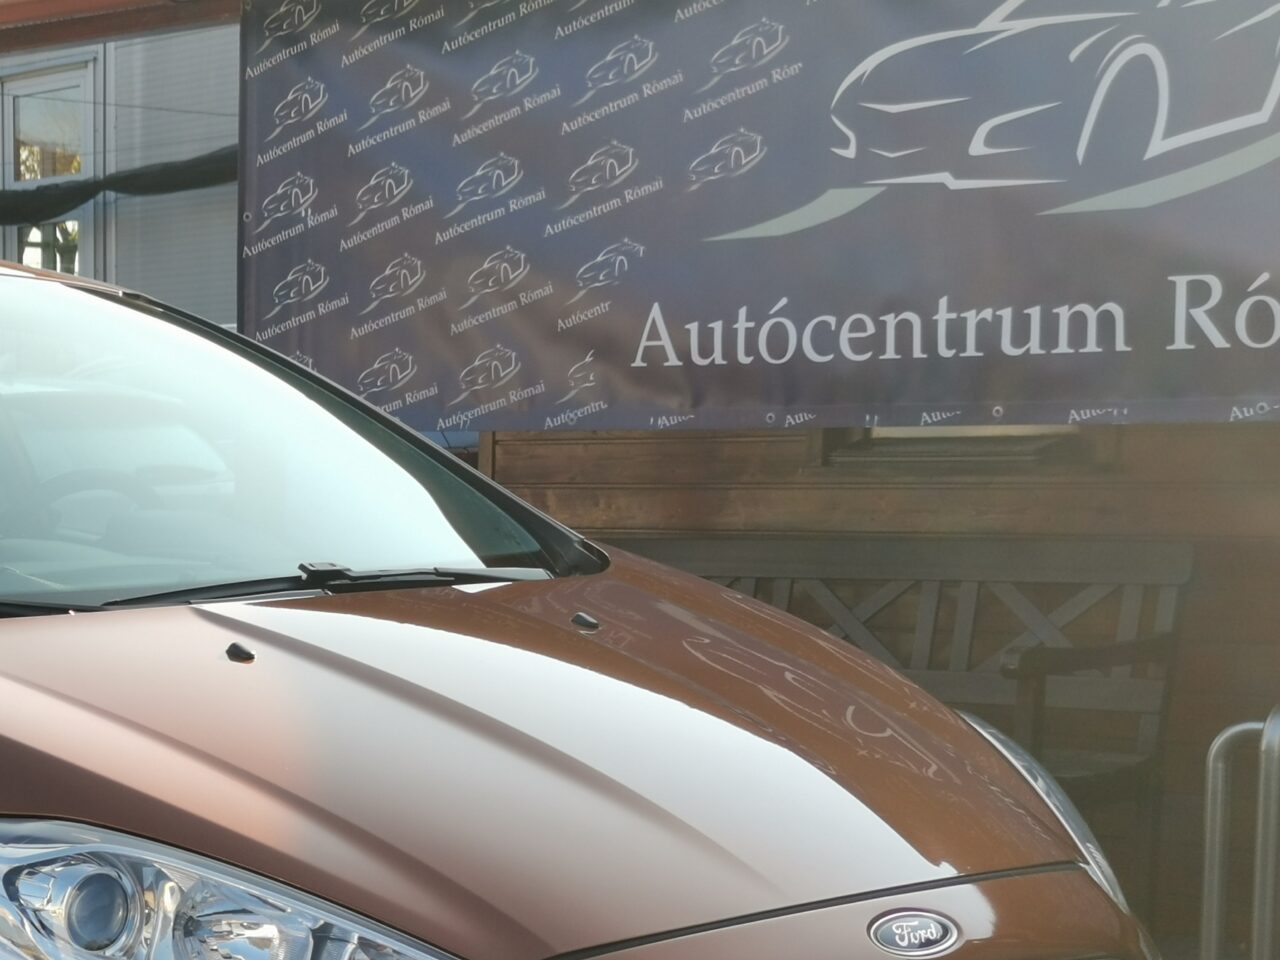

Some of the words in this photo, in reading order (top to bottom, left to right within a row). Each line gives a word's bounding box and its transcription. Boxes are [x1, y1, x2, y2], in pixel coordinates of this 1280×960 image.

[245, 40, 308, 80] Autócentrum
[309, 19, 340, 46] Római
[341, 25, 406, 68] Autócentrum
[409, 5, 445, 32] Római
[441, 11, 516, 54] Autócentrum
[347, 118, 416, 157] Autócentrum
[418, 97, 451, 124] Római
[452, 106, 522, 147] Autócentrum
[523, 83, 561, 112] Római
[560, 91, 639, 136] Autócentrum
[642, 69, 684, 98] Római
[683, 77, 768, 122] Autócentrum
[256, 128, 315, 167] Autócentrum
[316, 109, 348, 135] Római
[242, 221, 304, 258] Autócentrum
[307, 204, 338, 229] Római
[340, 215, 400, 252] Autócentrum
[401, 195, 434, 220] Római
[435, 206, 505, 245] Autócentrum
[508, 186, 546, 212] Római
[543, 195, 622, 238] Autócentrum
[624, 176, 664, 203] Római
[255, 309, 315, 343] Autócentrum
[317, 292, 350, 318] Római
[349, 304, 416, 341] Autócentrum
[416, 287, 448, 312] Római
[450, 299, 518, 336] Autócentrum
[519, 280, 554, 306] Római
[630, 296, 1132, 367] Autócentrum
[1166, 271, 1280, 350] Ró
[405, 382, 438, 405] Római
[436, 398, 507, 431] Autócentrum
[508, 380, 545, 404] Római
[892, 921, 938, 946] Ford
